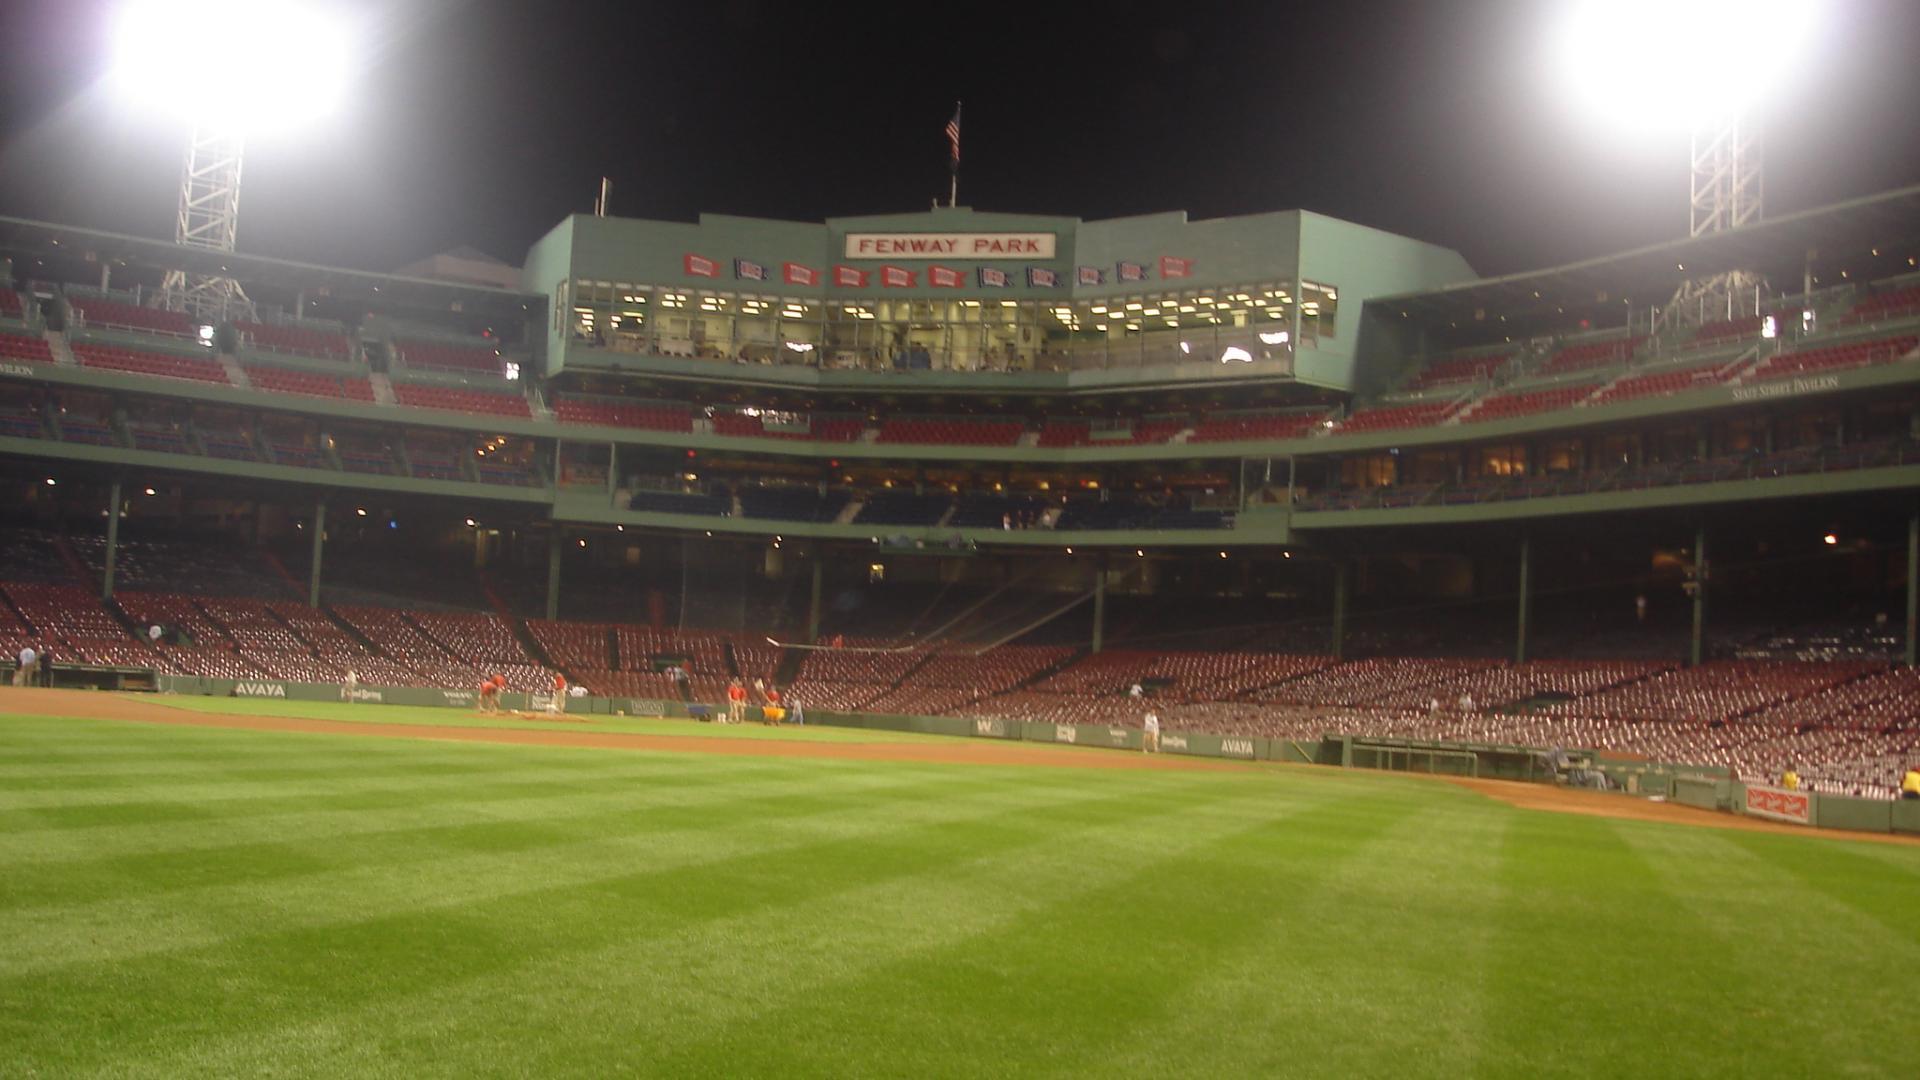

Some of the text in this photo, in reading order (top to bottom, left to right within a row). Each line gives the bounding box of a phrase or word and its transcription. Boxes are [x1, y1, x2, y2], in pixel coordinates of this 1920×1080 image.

[858, 238, 1040, 254] FENWAY PARK
[1732, 375, 1840, 400] STATE STREET PAVILION
[236, 682, 286, 697] AVAYA
[1221, 738, 1254, 755] AVAYA
